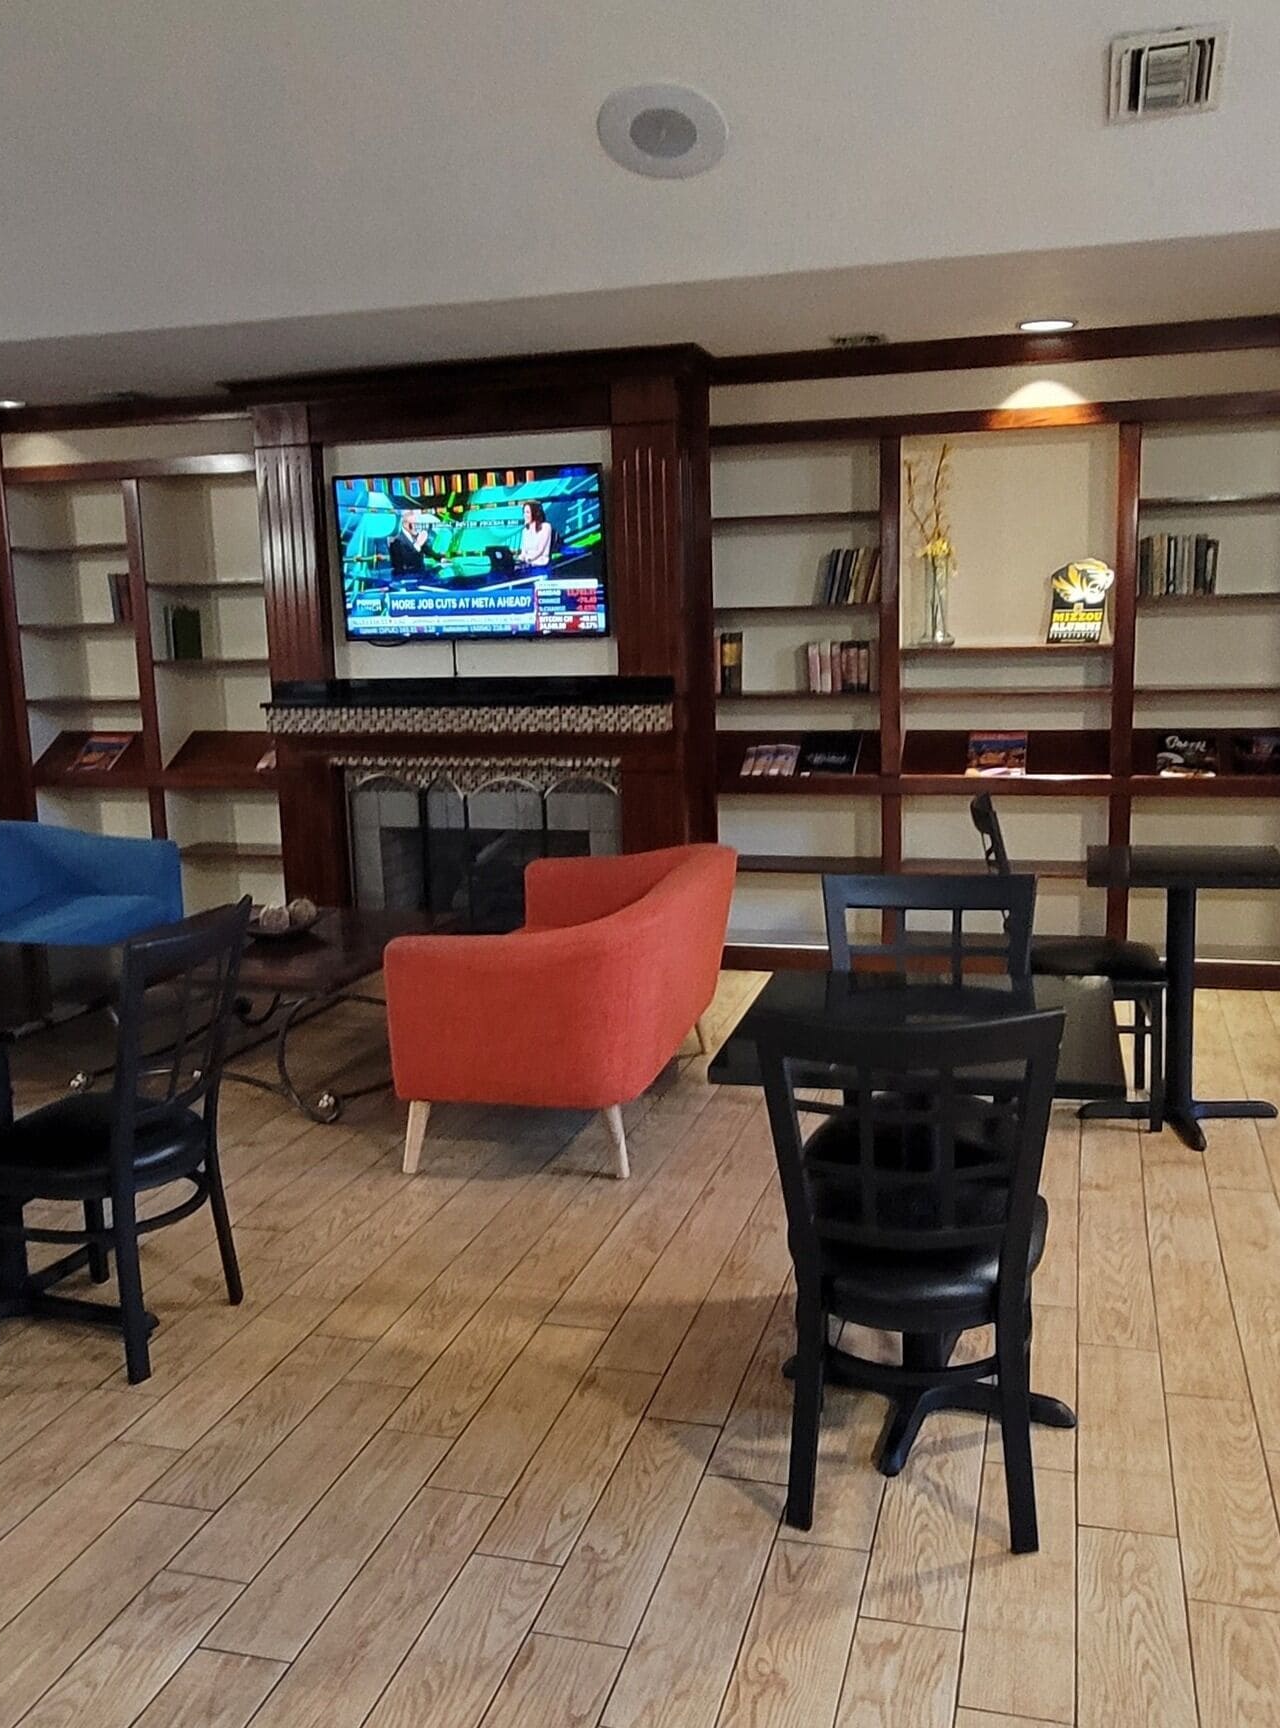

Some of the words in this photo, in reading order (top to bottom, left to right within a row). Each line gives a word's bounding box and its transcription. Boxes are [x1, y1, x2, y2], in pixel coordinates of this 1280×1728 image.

[391, 599, 415, 610] MORE
[417, 599, 434, 610] JOB
[435, 597, 457, 609] CUTS
[459, 597, 470, 609] AT
[471, 597, 495, 608] META
[496, 596, 531, 608] AHEAD?
[1053, 612, 1103, 622] MIZZOU
